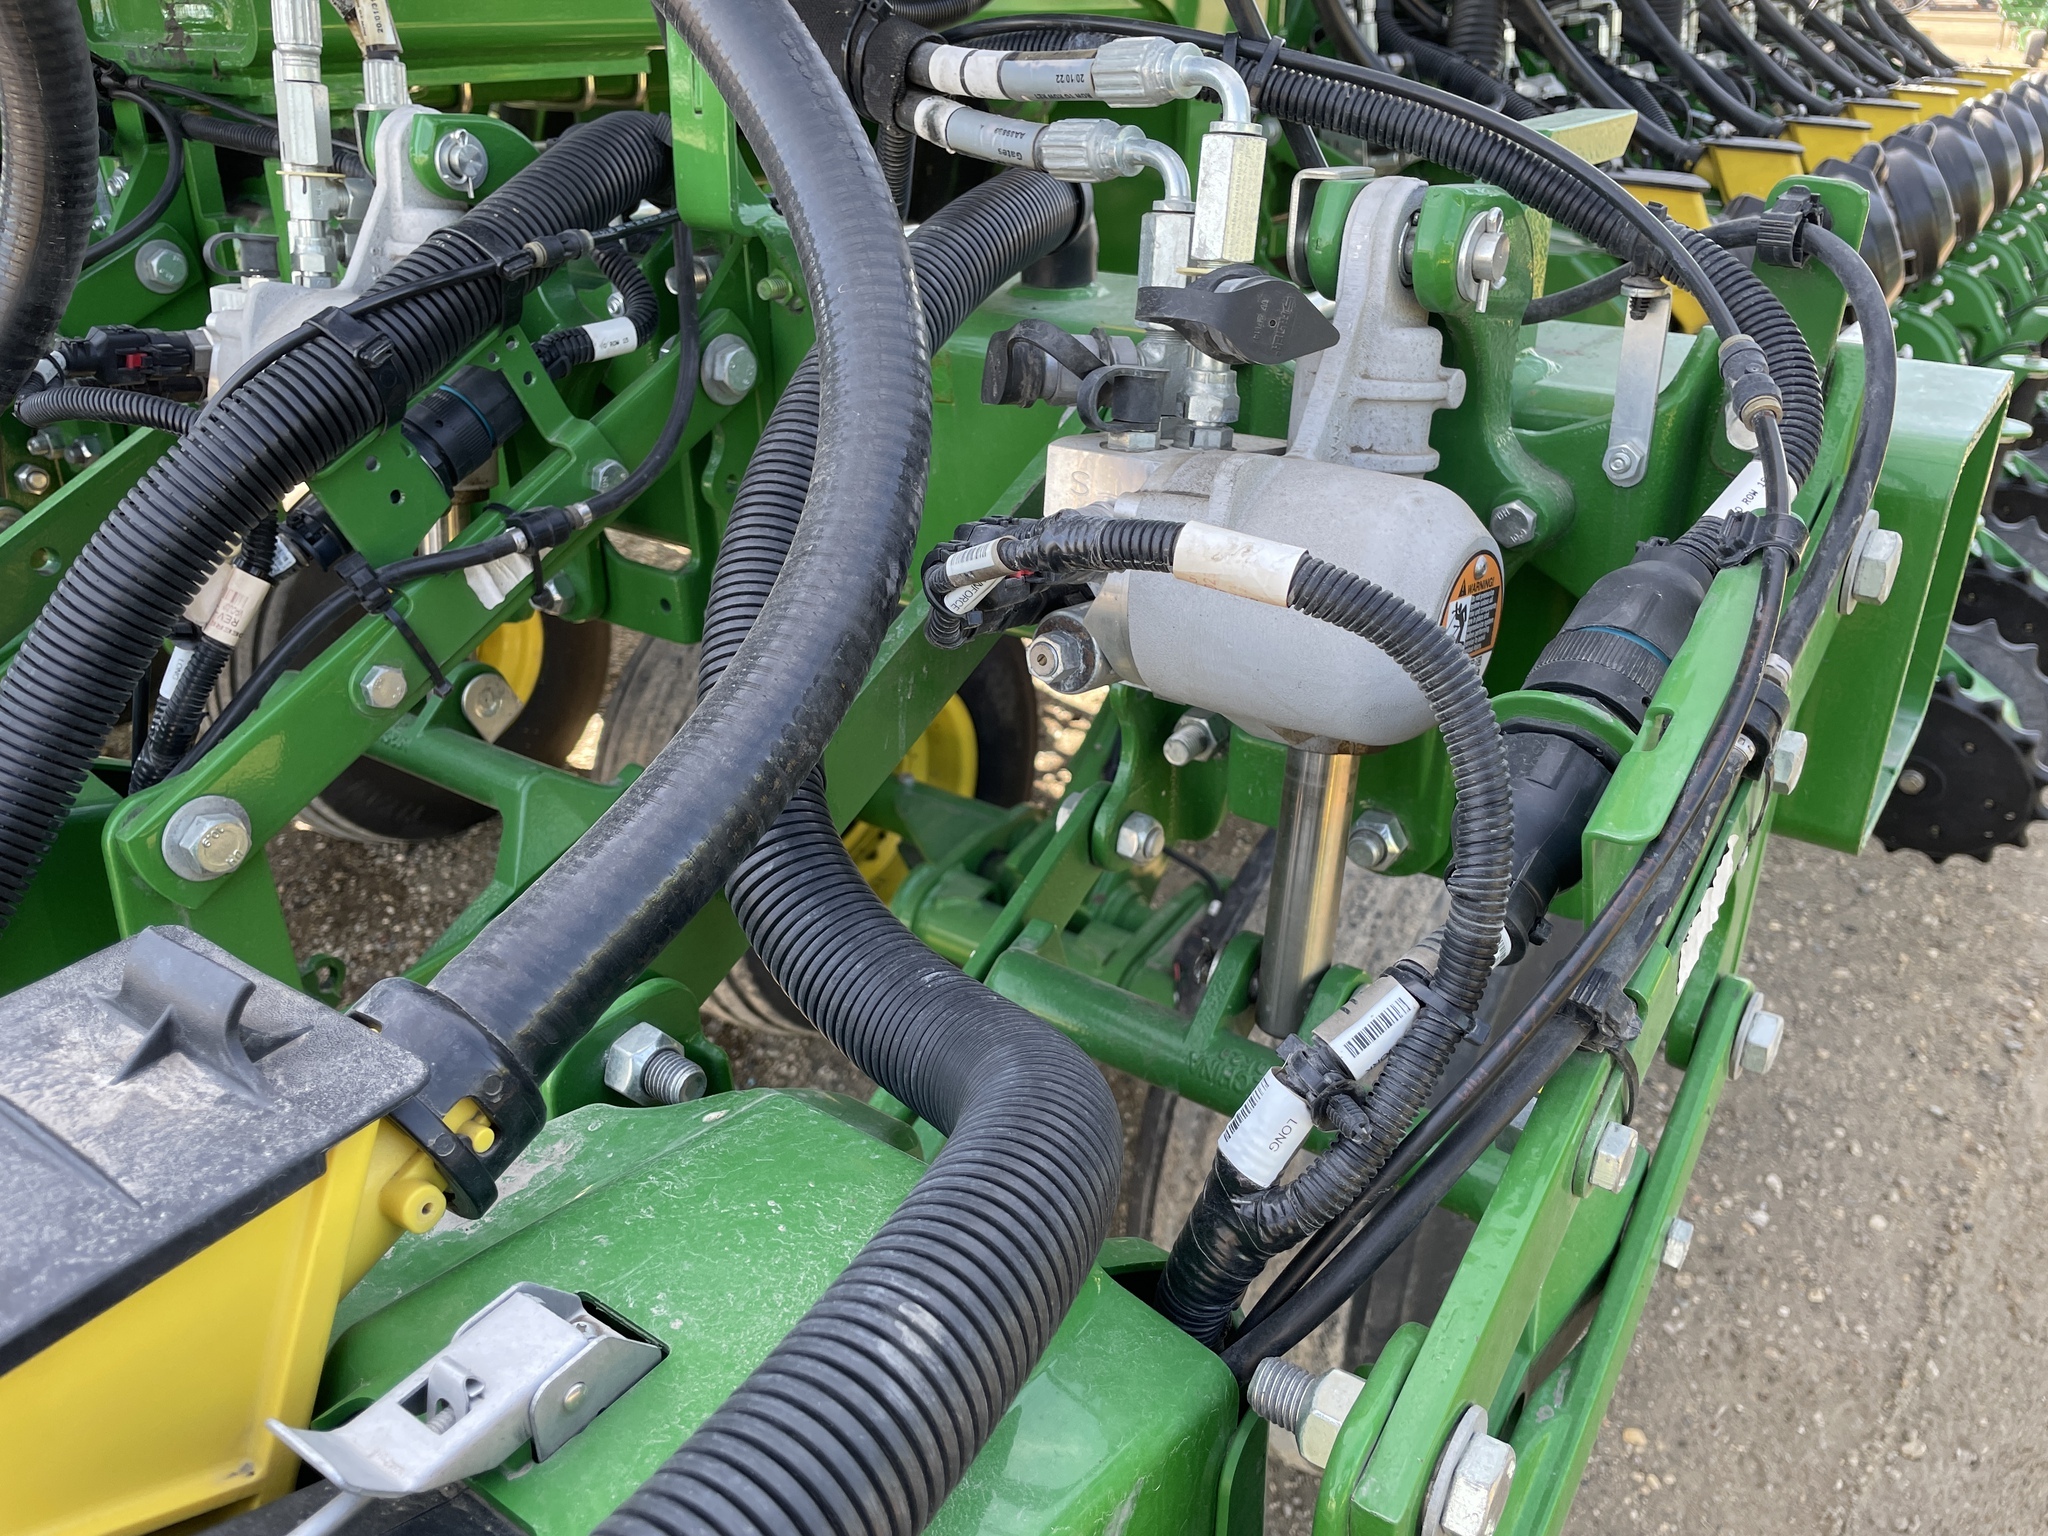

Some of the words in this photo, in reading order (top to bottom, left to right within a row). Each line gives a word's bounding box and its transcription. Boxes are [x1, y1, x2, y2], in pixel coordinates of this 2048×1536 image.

[998, 148, 1023, 160] Gates
[1071, 471, 1090, 496] S
[1742, 488, 1758, 505] ROW
[1468, 579, 1495, 593] WARNING!
[1268, 1118, 1297, 1151] LONG
